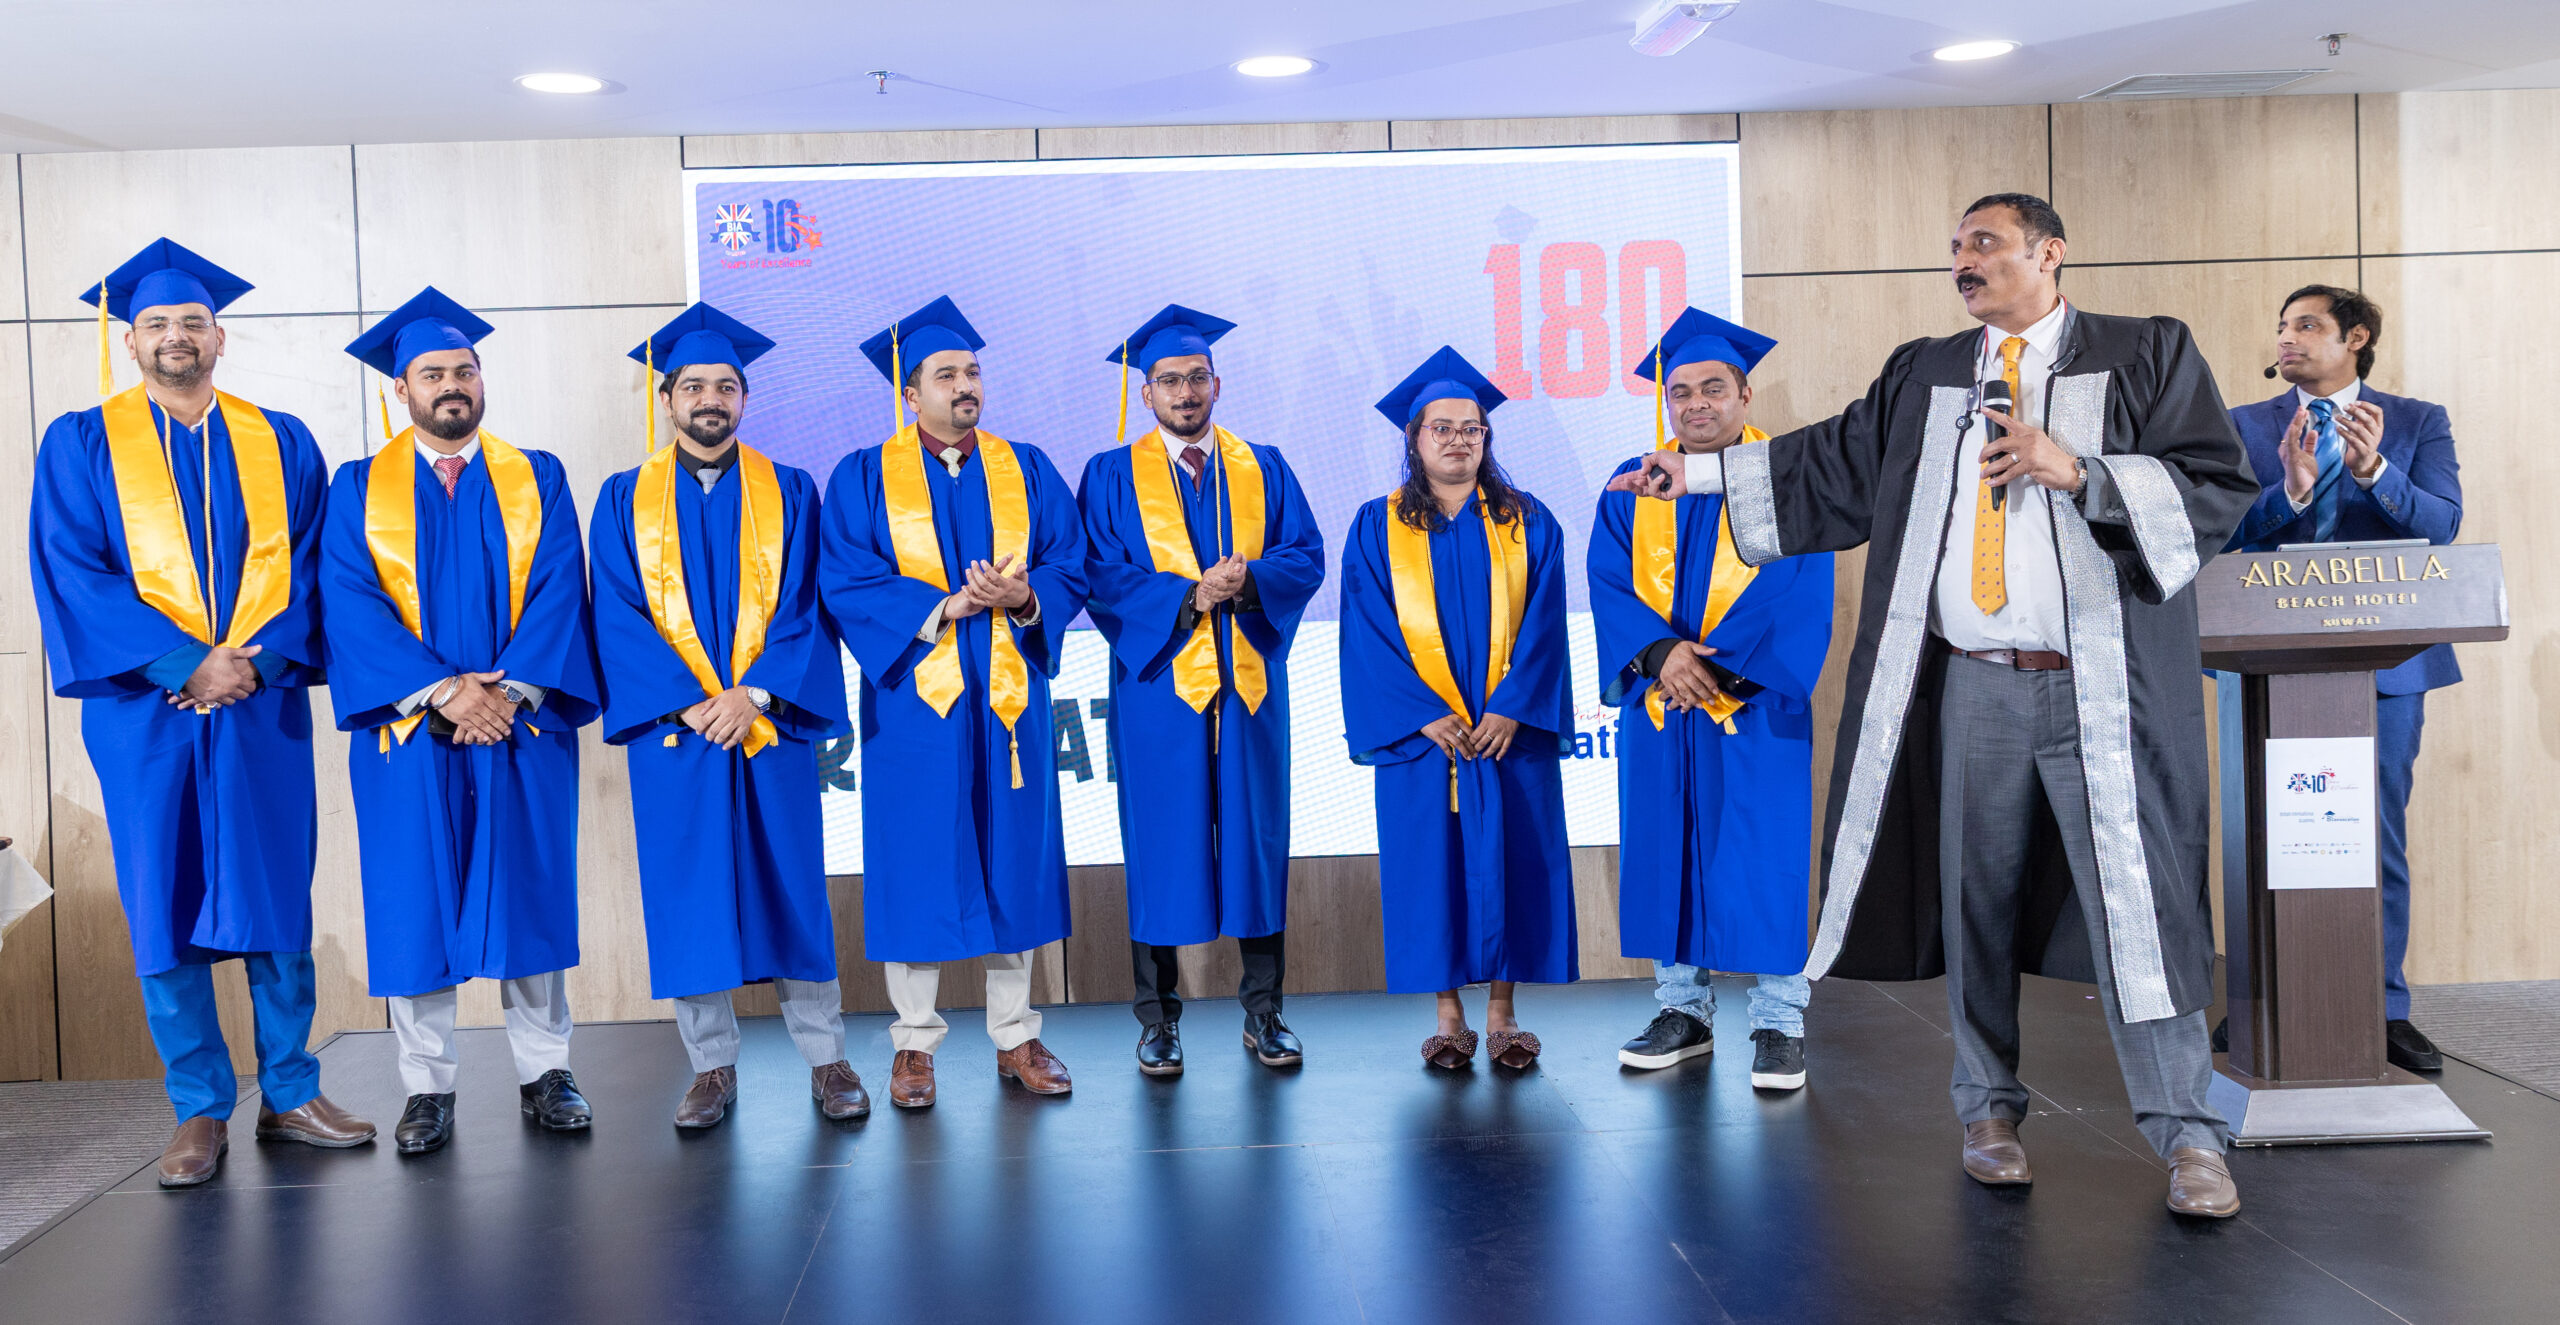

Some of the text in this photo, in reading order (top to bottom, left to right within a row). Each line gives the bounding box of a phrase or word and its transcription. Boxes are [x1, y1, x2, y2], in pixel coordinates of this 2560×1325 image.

[726, 222, 744, 232] BIA
[762, 199, 800, 253] 10
[720, 258, 747, 269] Years
[748, 257, 760, 269] of
[1482, 239, 1688, 401] 180
[2239, 554, 2451, 588] ARABELLA
[2275, 595, 2345, 609] BEACH
[2311, 774, 2327, 793] 10
